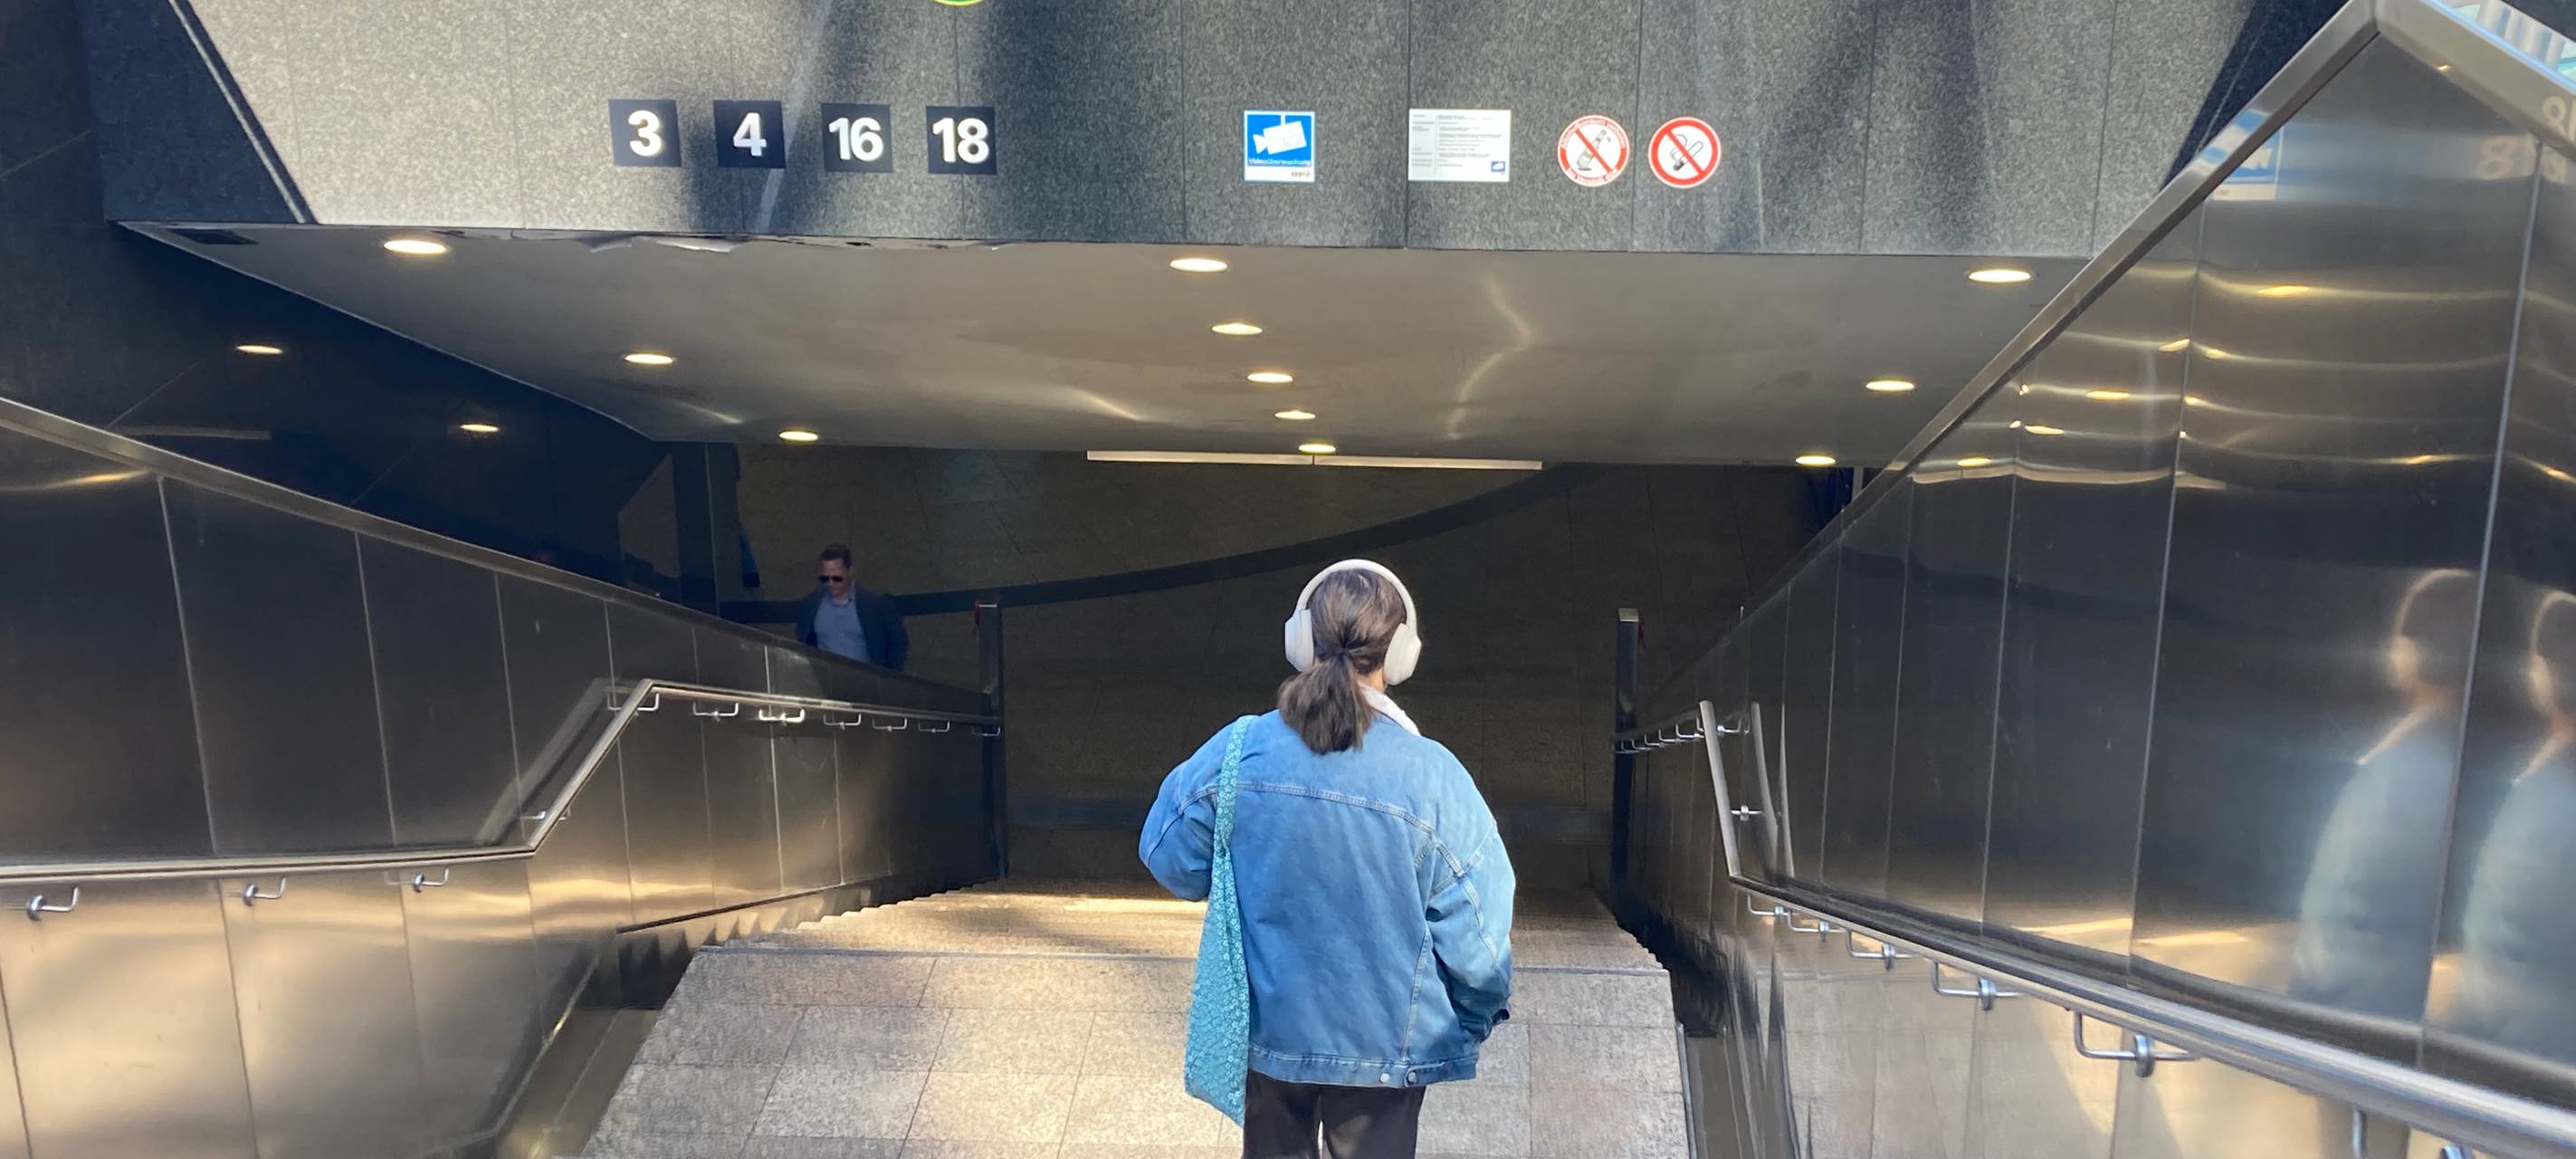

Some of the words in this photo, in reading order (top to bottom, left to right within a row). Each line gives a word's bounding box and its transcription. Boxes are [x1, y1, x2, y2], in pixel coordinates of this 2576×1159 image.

[629, 110, 661, 158] 3
[733, 112, 768, 157] 4
[829, 117, 884, 161] 16
[932, 118, 989, 163] 18
